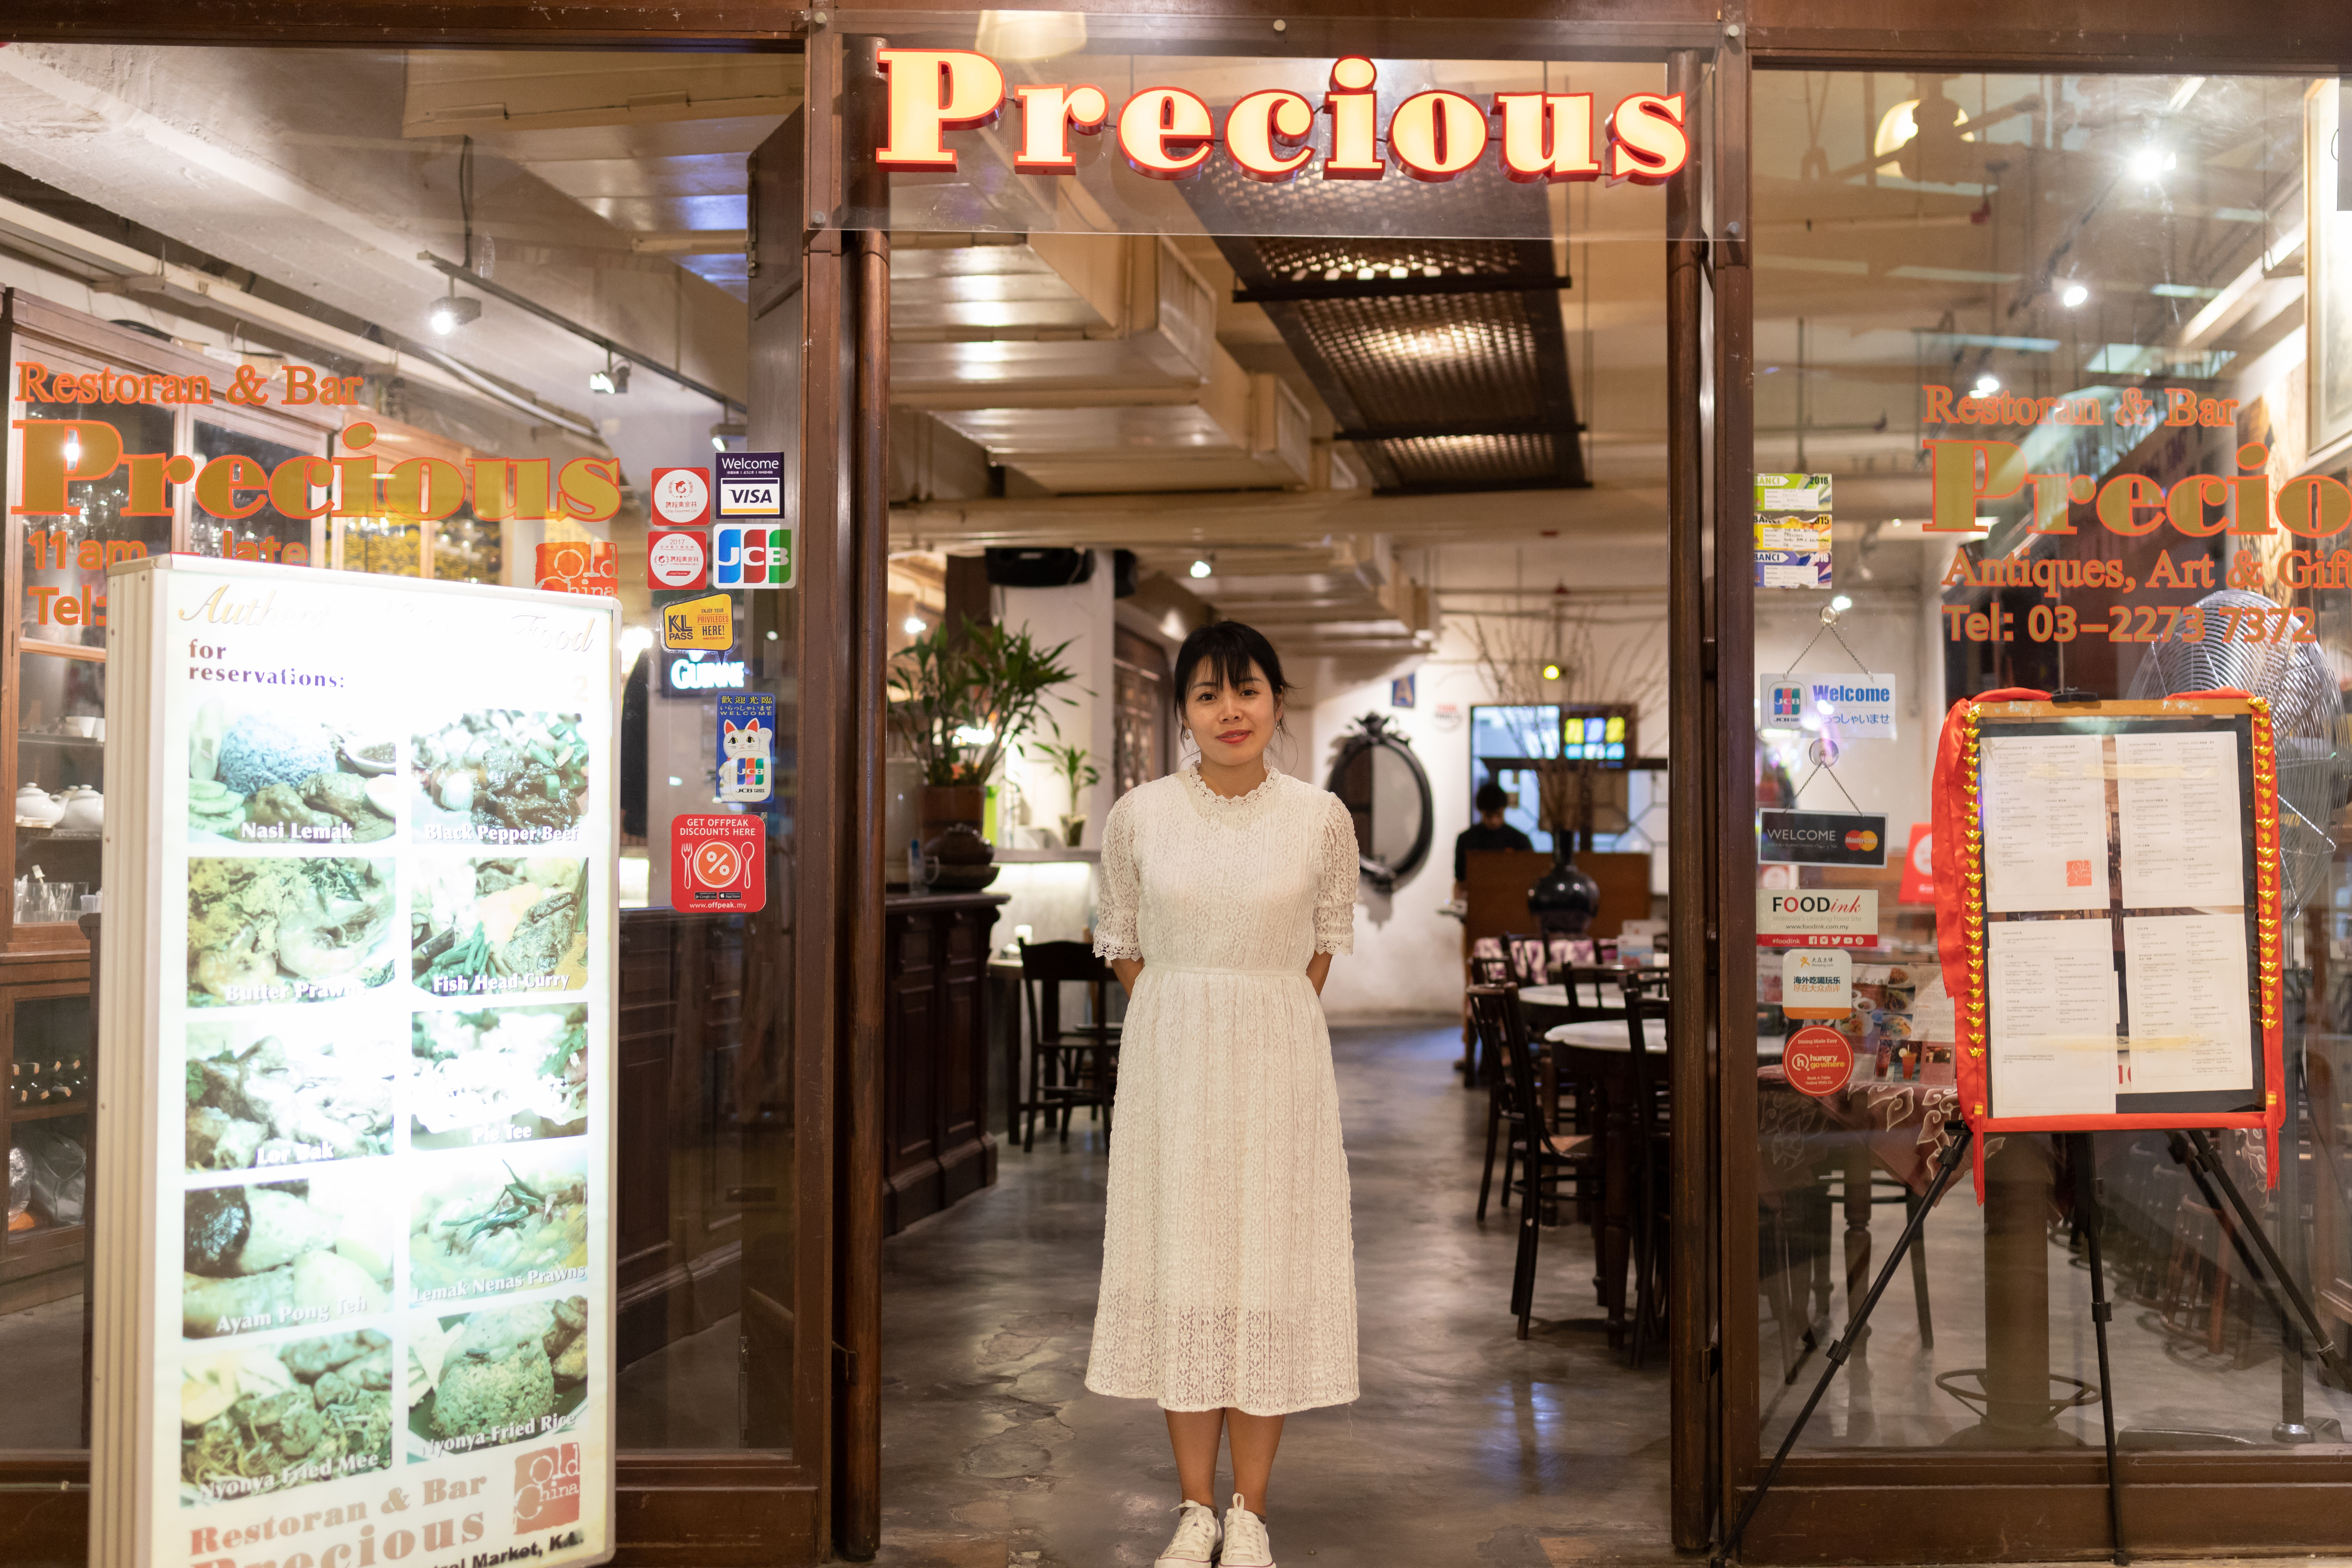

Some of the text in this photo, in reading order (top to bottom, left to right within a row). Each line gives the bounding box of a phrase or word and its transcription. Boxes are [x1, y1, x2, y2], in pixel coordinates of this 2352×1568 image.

[876, 48, 1690, 185] Precious
[15, 362, 364, 405] Restoran & Bar
[1923, 385, 2239, 427] Restoran & Bar
[11, 420, 622, 522] Precious
[722, 457, 779, 469] Welcome
[728, 489, 772, 503] VISA
[554, 542, 618, 578] Old
[718, 547, 789, 566] JCB
[1942, 548, 2136, 598] Antiques,
[2145, 549, 2214, 587] Art
[2226, 550, 2264, 589] &
[28, 585, 106, 626] Tel:
[668, 615, 692, 632] KL
[697, 615, 729, 623] PRIVILEGES
[1942, 602, 2014, 641] Tel:
[2219, 606, 2316, 643] 7372
[669, 632, 693, 640] PASS
[703, 625, 724, 635] HERE!
[189, 639, 227, 660] for
[189, 664, 345, 689] reservations:
[721, 696, 772, 704] 歡迎光臨
[1813, 685, 1890, 701] Welcome
[241, 822, 353, 840] Nasi Lemak
[424, 824, 579, 845] Black Pepper Beef
[680, 828, 729, 836] DISCOUNTS
[1767, 829, 1836, 841] WELCOME
[1773, 895, 1861, 913] FOODink
[433, 972, 570, 993] Fish Head Curry
[1793, 984, 1840, 992] 尽在大众点评
[1794, 976, 1841, 984] 海外吃喝玩乐
[226, 982, 289, 1001] Butter
[1810, 1054, 1838, 1062] hungry
[504, 1124, 533, 1140] Tee
[414, 1265, 585, 1302] Lemak Nenas Prawns
[216, 1297, 368, 1332] Ayam Pong Teh
[491, 1423, 535, 1440] Fried
[541, 1413, 576, 1430] Rice
[530, 1442, 580, 1483] Old
[199, 1454, 379, 1502] Nyonya Fried Mee
[514, 1479, 580, 1520] China
[190, 1475, 487, 1556] Restoran & Bar
[190, 1511, 485, 1568] ecious
